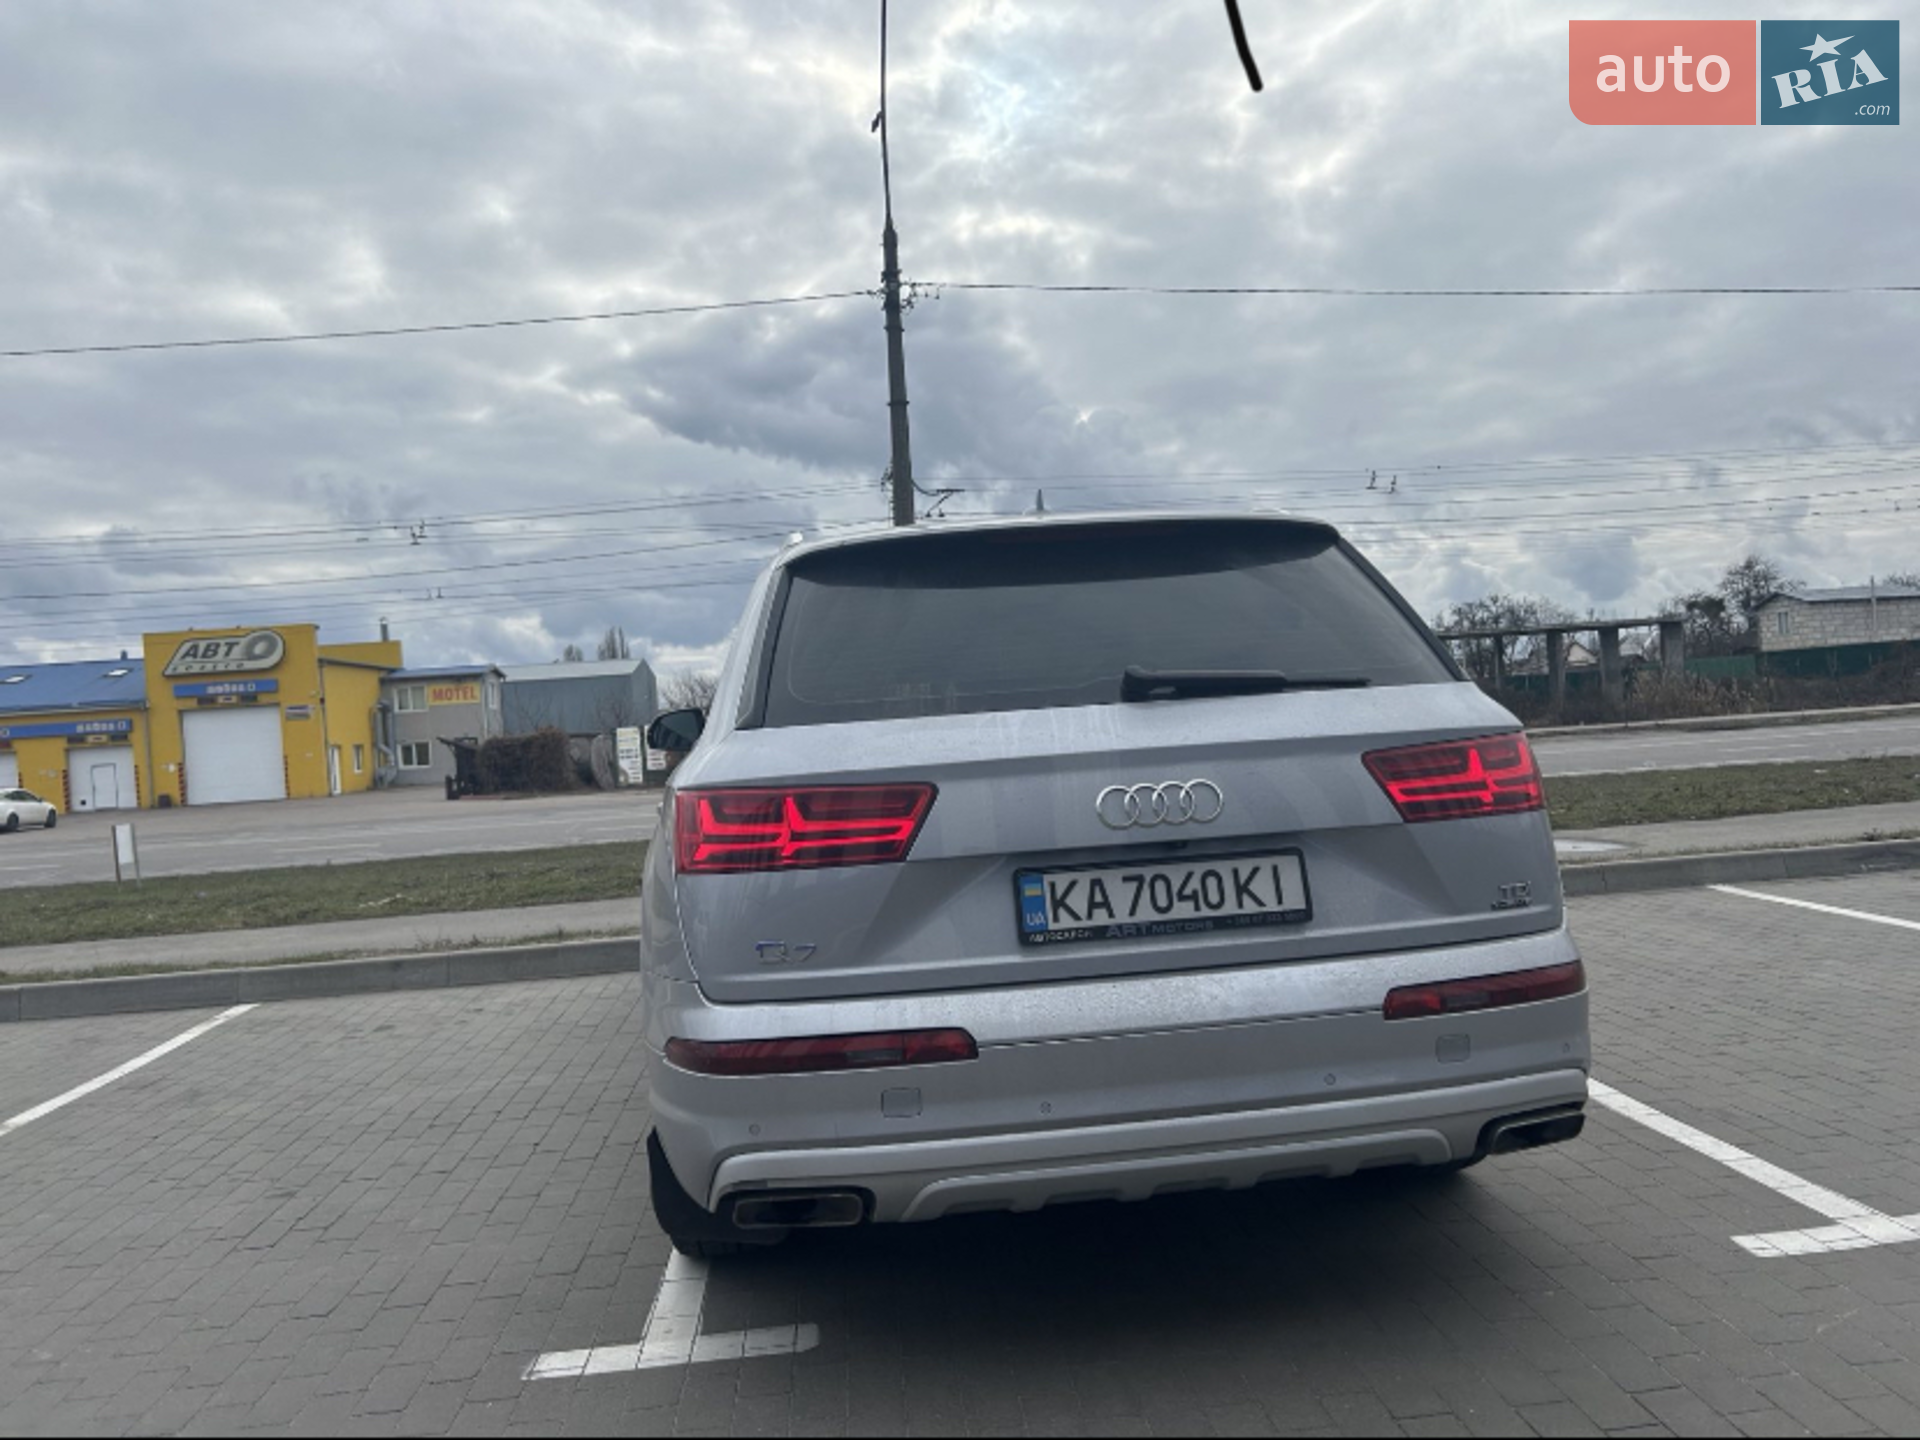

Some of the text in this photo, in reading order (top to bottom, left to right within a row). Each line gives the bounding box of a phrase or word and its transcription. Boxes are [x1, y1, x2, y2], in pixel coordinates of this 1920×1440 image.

[431, 685, 478, 703] MOTEL
[1026, 910, 1046, 927] UA
[755, 941, 817, 965] Q7
